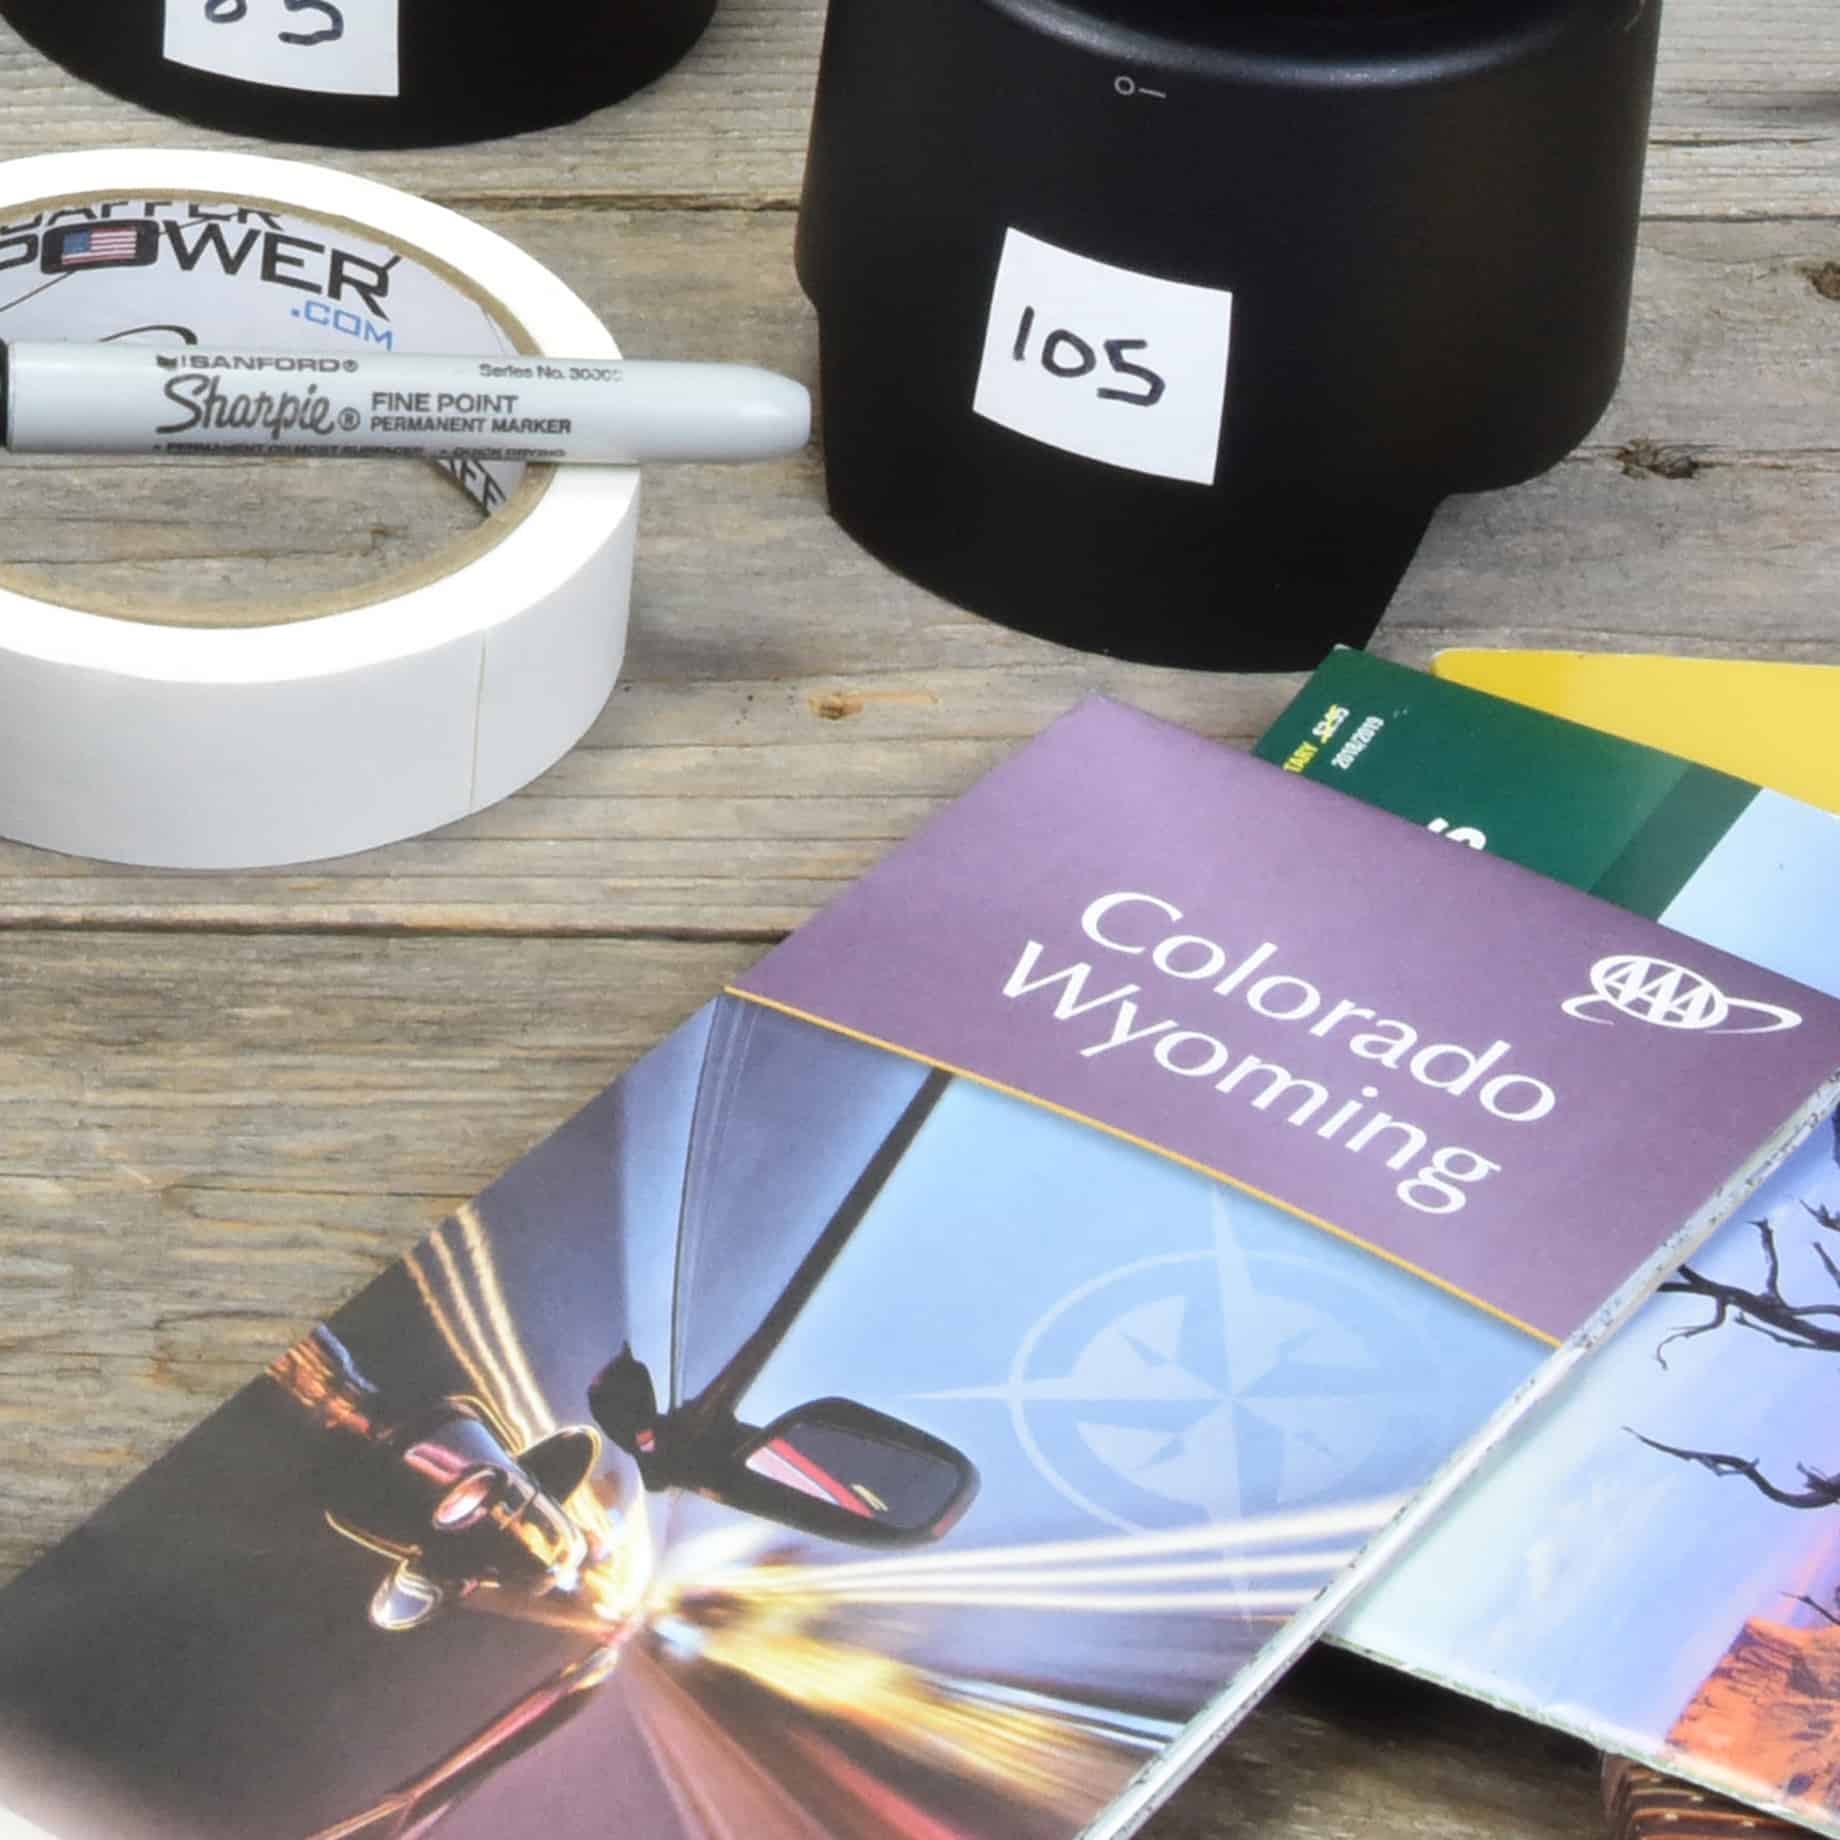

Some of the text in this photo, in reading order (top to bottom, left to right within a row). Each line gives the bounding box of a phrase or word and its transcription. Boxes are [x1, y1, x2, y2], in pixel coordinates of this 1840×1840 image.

[479, 363, 533, 379] Series
[1012, 305, 1166, 407] 105
[370, 392, 519, 416] FINE POINT
[370, 416, 571, 435] PERMANENT MARKER
[1080, 890, 1558, 1124] Colorado
[1598, 957, 1711, 1029] AAA
[1000, 939, 1502, 1215] Wyoming
